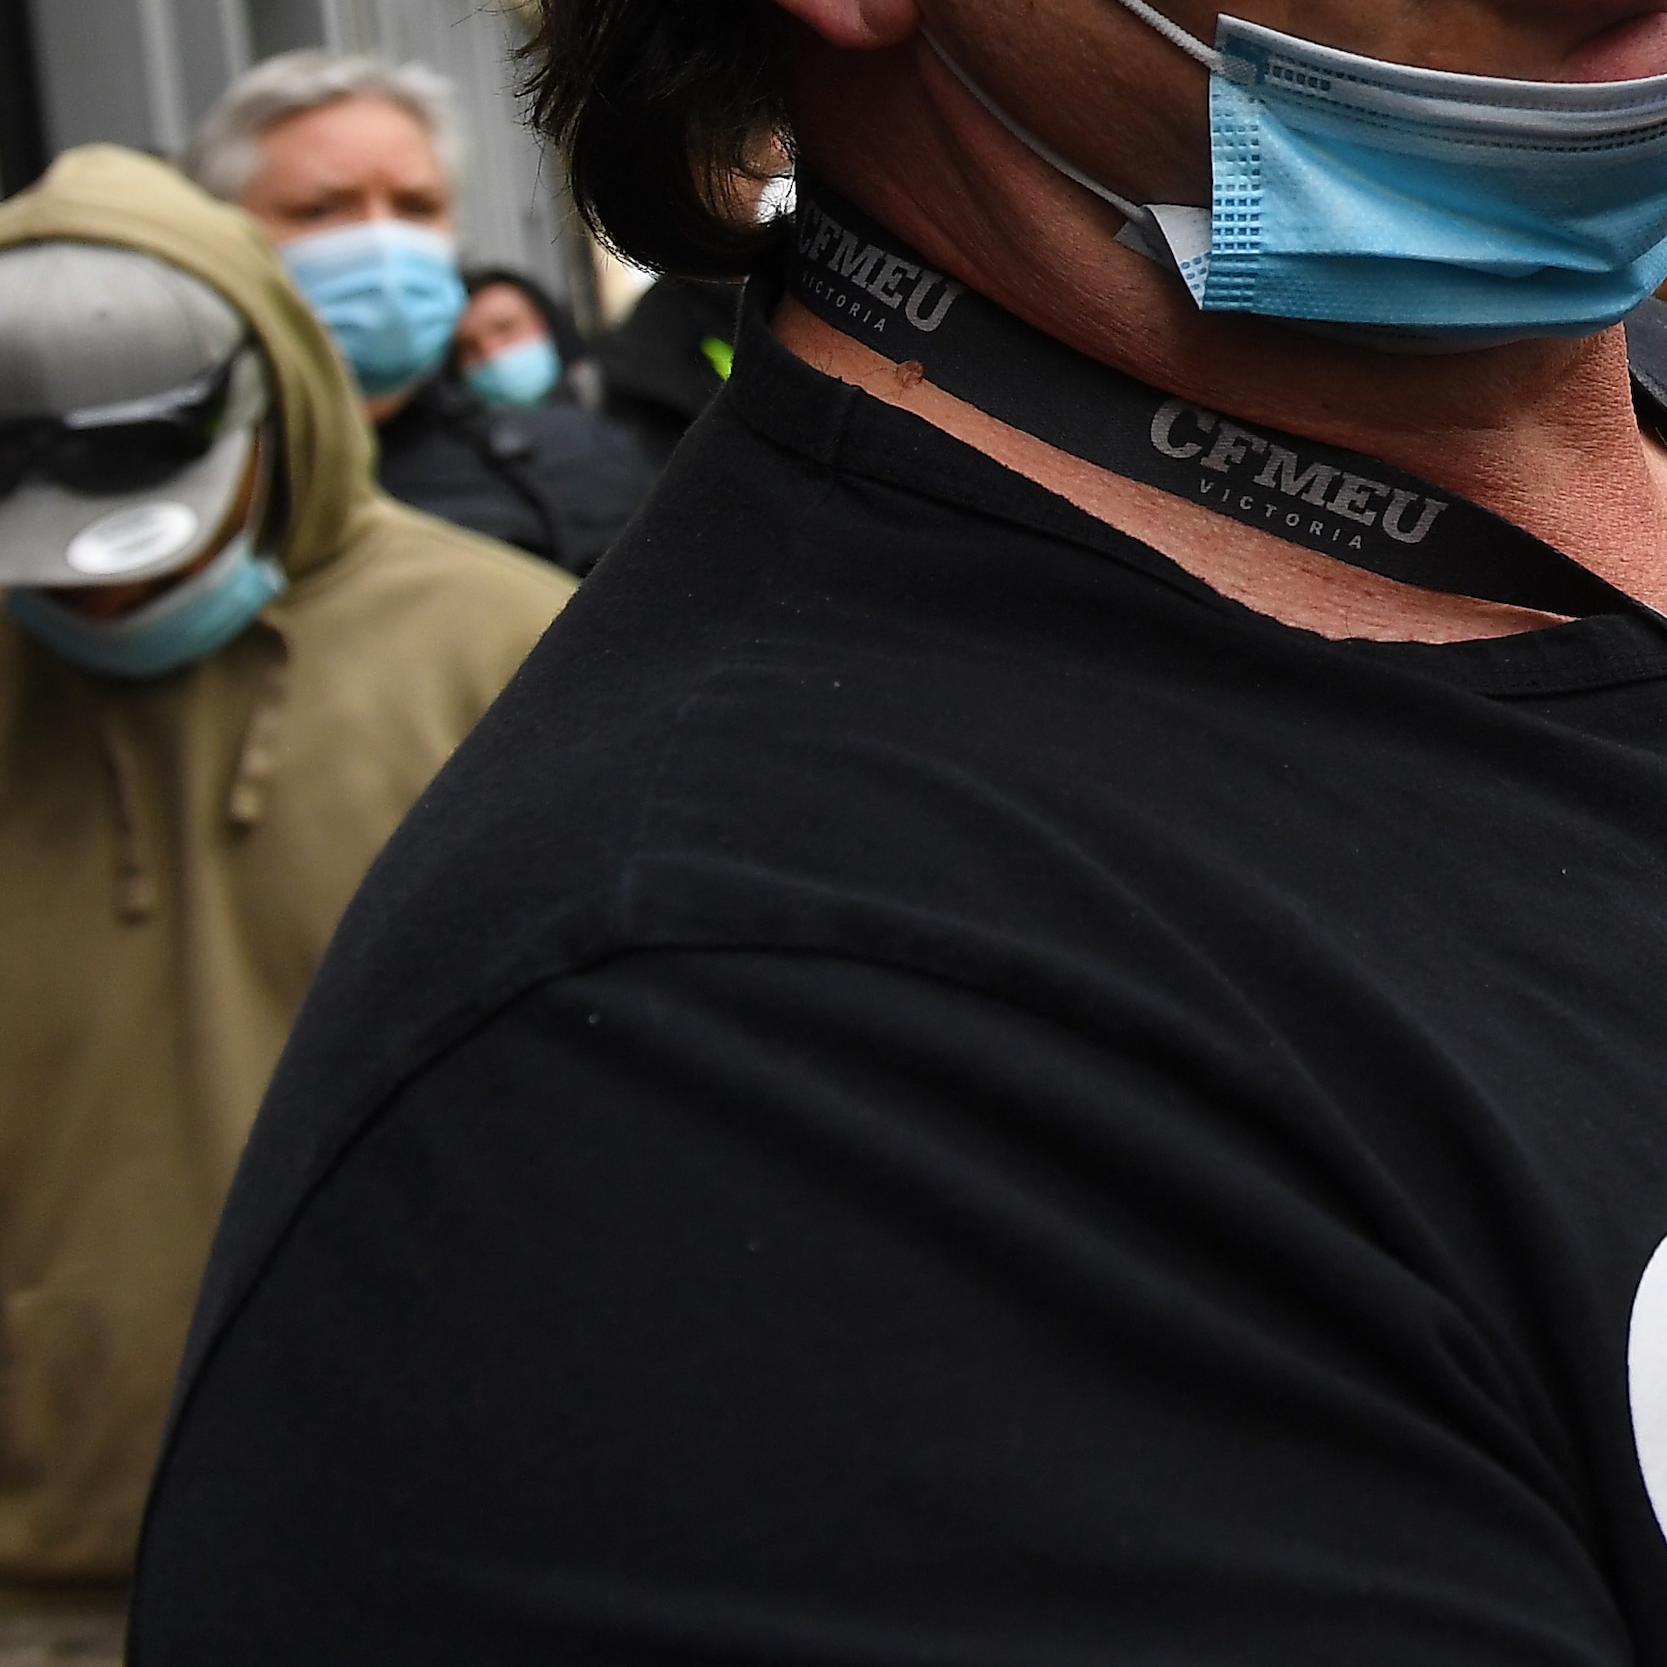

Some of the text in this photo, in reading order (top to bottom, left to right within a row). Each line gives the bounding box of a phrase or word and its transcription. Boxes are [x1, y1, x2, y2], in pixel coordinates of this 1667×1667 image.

[798, 197, 966, 332] CFMEU
[1150, 399, 1449, 544] CFMEU
[1199, 478, 1364, 550] VICTORIA
